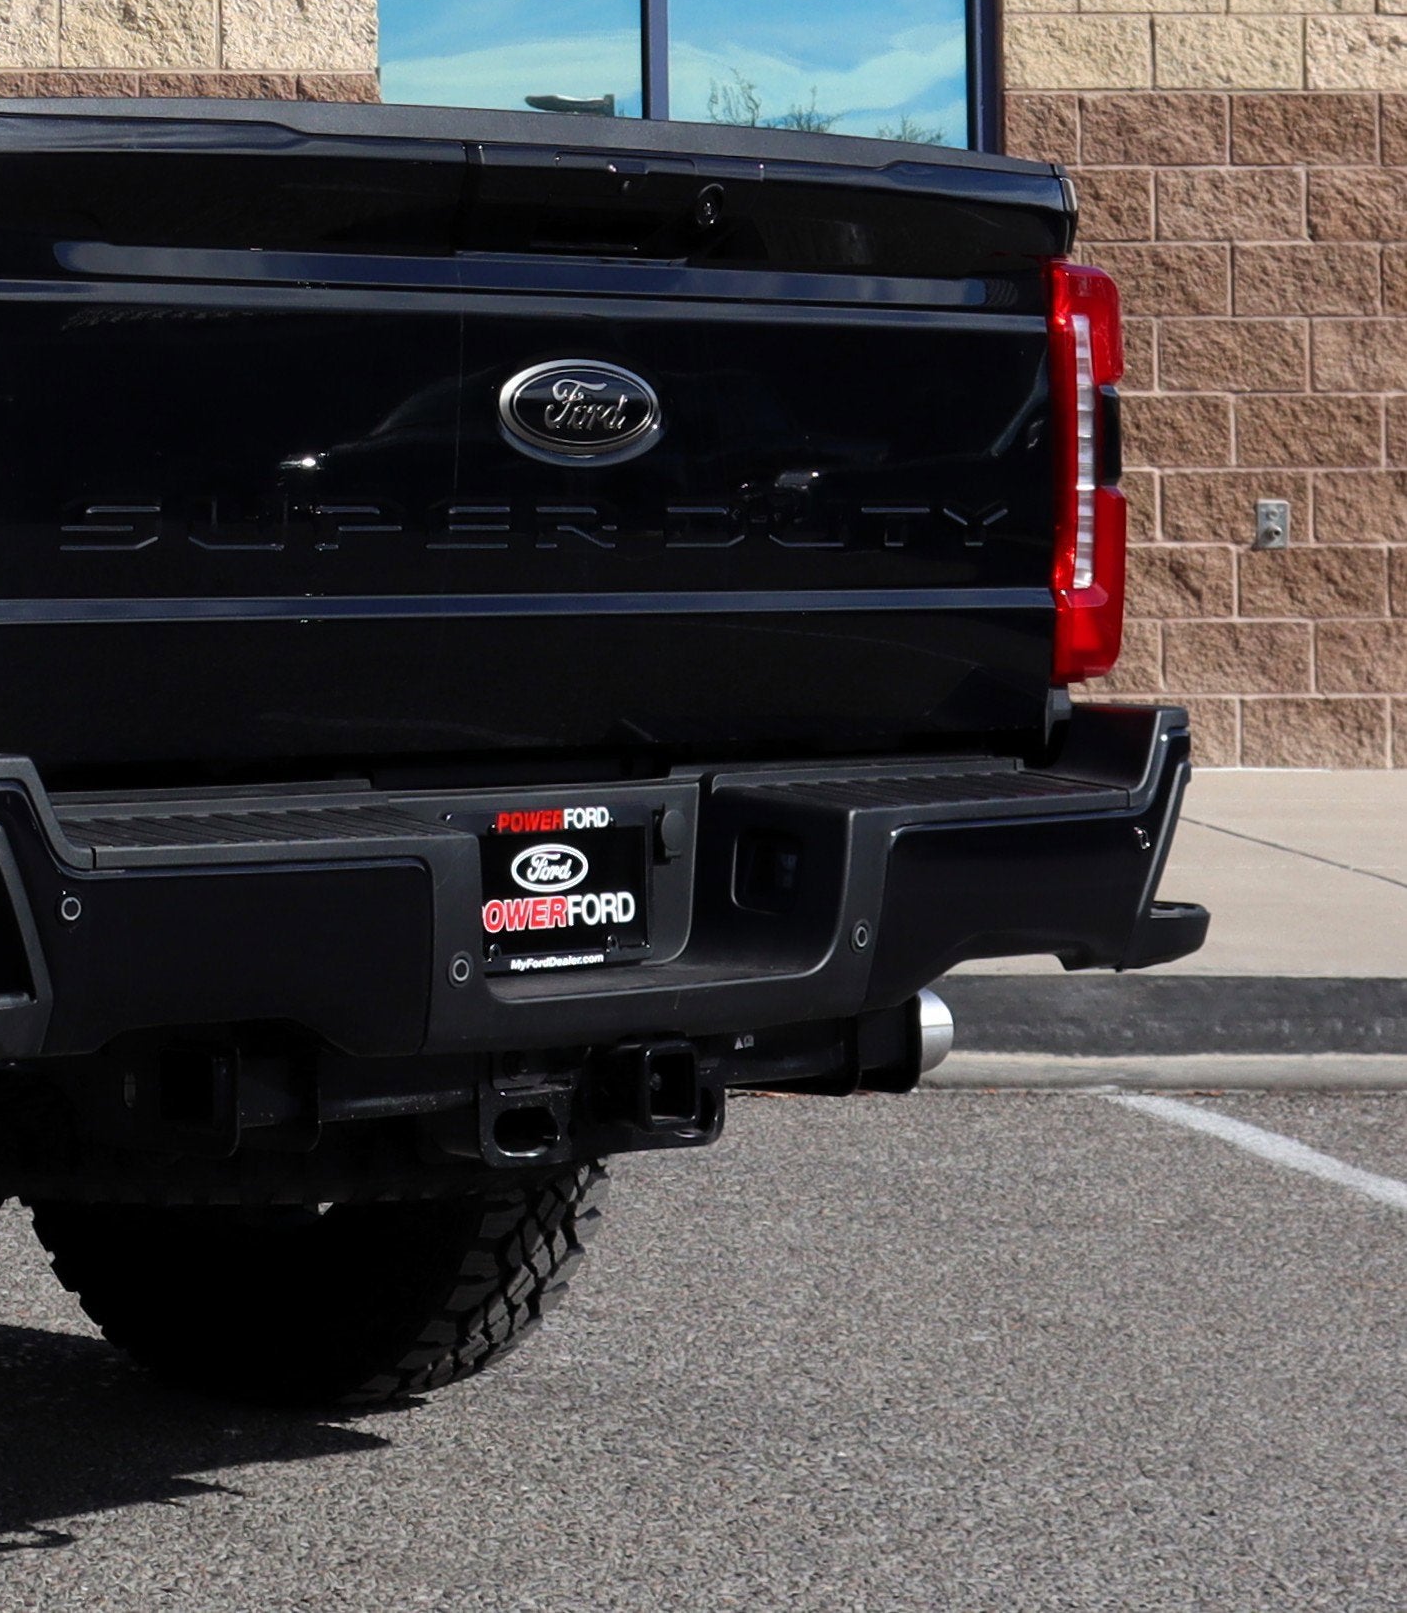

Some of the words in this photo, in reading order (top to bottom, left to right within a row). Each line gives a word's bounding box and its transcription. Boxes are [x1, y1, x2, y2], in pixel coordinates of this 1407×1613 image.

[544, 378, 628, 430] Ford
[59, 502, 619, 552] SUPER
[663, 503, 1009, 552] DUTY
[526, 853, 572, 881] Ford
[482, 891, 636, 933] OWERFORD
[510, 954, 604, 971] MyFordDealer.com
